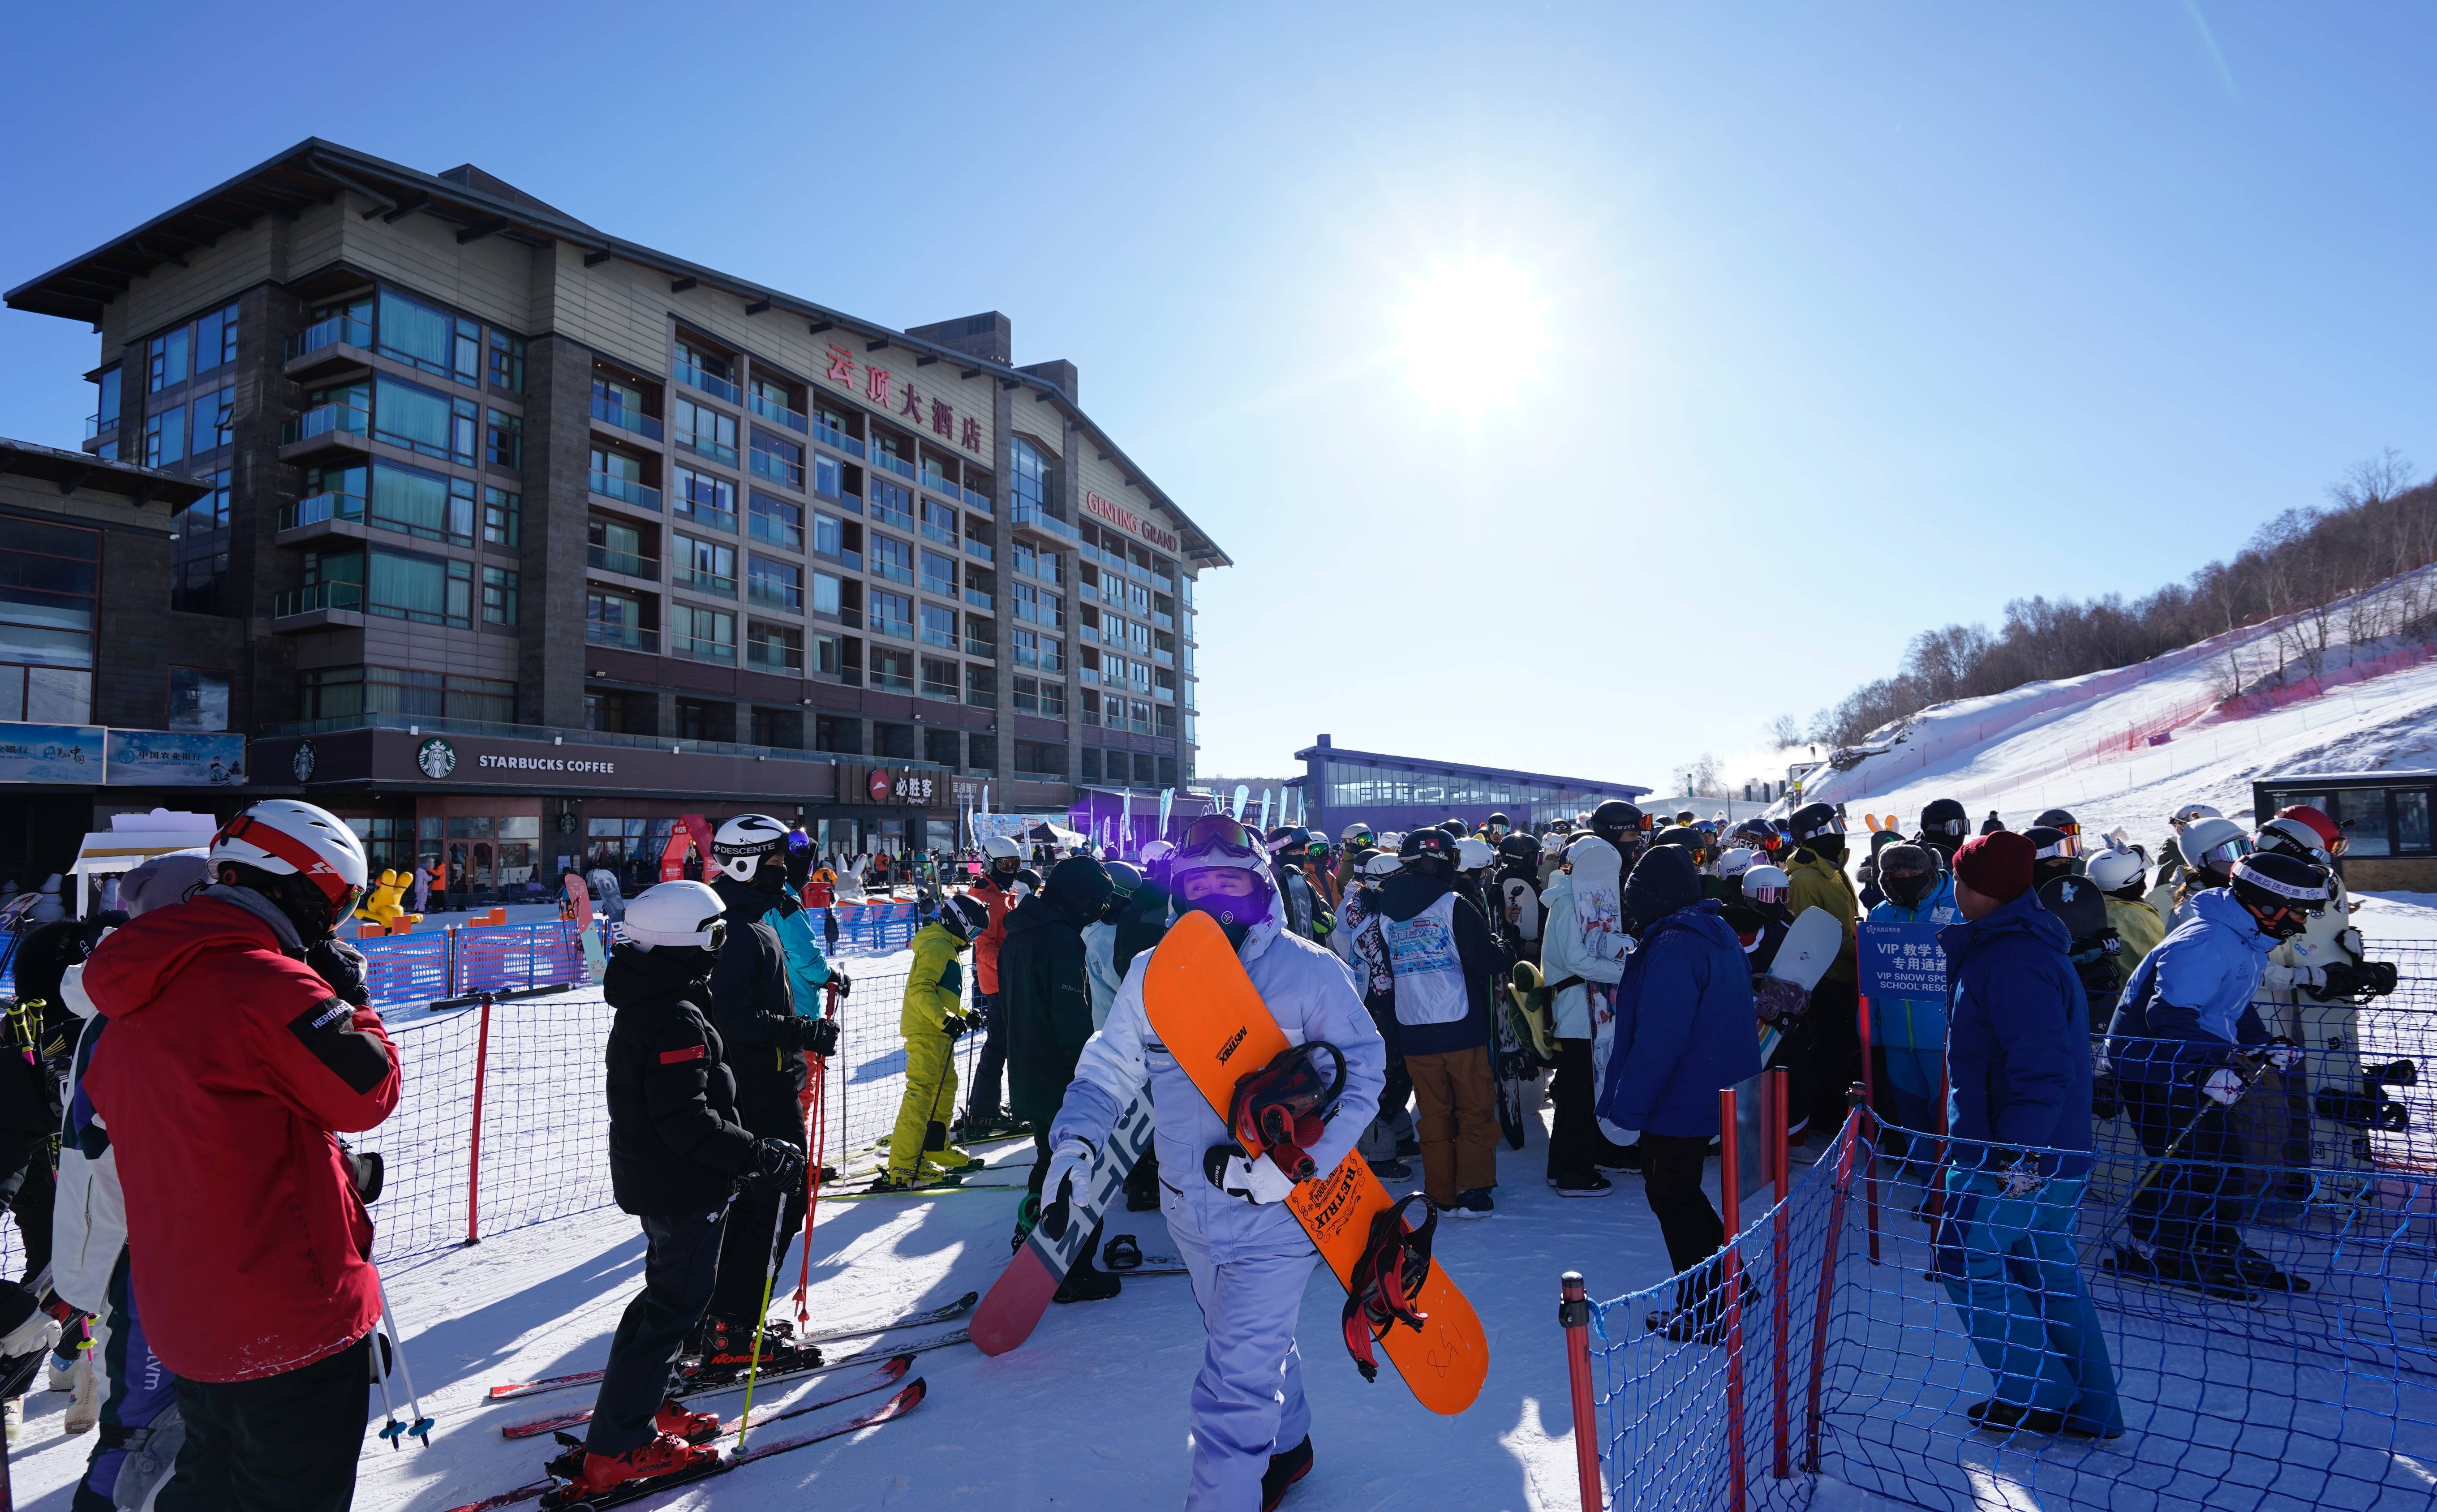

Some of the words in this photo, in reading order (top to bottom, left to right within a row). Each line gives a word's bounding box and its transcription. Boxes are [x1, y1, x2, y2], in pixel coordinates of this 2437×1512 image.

[826, 344, 982, 454] 云顶大酒店
[1087, 491, 1139, 533] GENTING
[1142, 520, 1178, 553] GRAND
[139, 751, 201, 761] 中国农业银行
[479, 755, 563, 771] STARBUCKS
[567, 760, 614, 774] COFFEE
[896, 777, 933, 797] 必胜客
[953, 782, 978, 794] 蓝湖餐厅
[721, 842, 775, 855] DESCENTE
[2277, 834, 2301, 853] GIRO
[1726, 863, 1747, 873] OAKLEY
[1877, 943, 1900, 954] VIP
[1903, 943, 1931, 957] 教学
[1892, 957, 1947, 971] 专用通道
[1876, 972, 1892, 980] VIP
[1894, 973, 1925, 982] SNOW
[1880, 981, 1920, 991] SCHOOL
[311, 1002, 349, 1029] HERITAGE
[1215, 1035, 1234, 1060] SNOWBOARDS
[892, 1167, 938, 1178] FISCHER
[1314, 1182, 1327, 1201] 2004
[1314, 1166, 1356, 1230] RETRIX
[710, 1352, 774, 1364] NORDCA
[636, 1461, 672, 1473] ATOMIC
